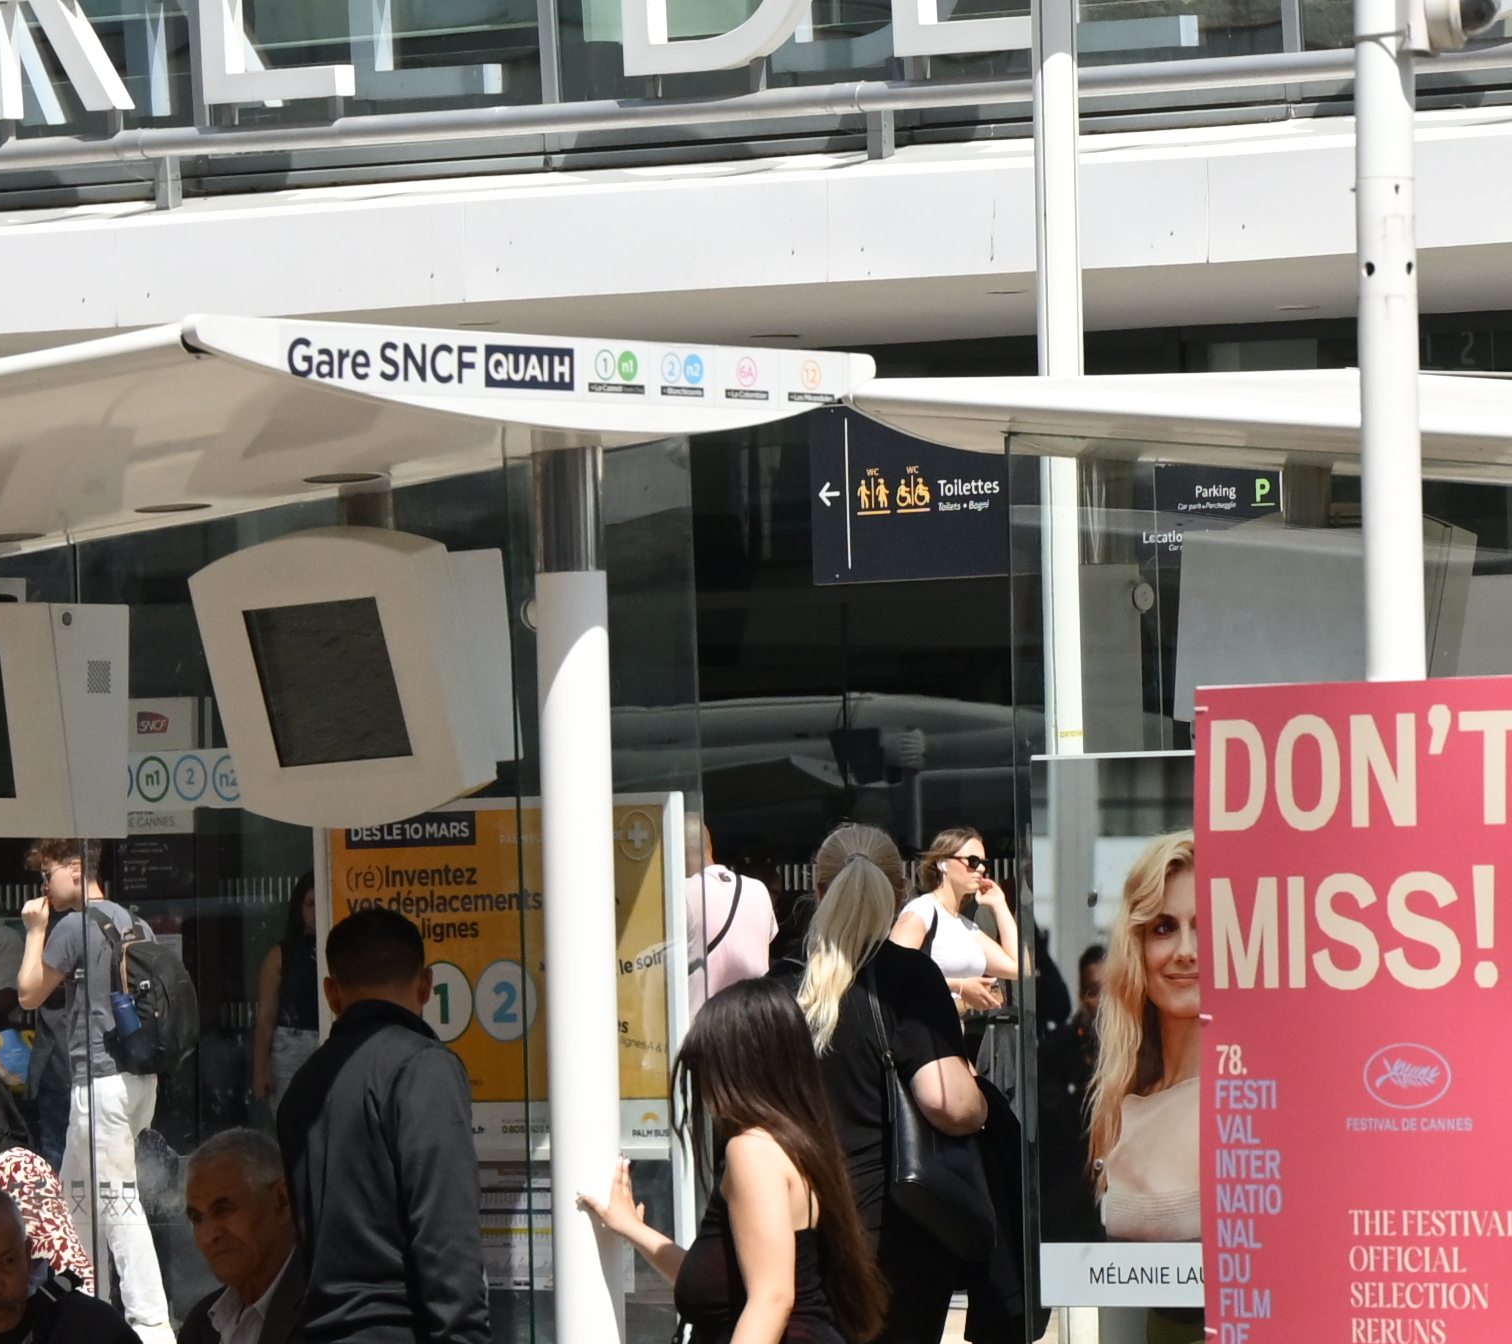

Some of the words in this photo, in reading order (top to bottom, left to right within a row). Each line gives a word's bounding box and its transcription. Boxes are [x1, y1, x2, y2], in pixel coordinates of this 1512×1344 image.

[287, 336, 370, 382] Gare
[380, 341, 478, 386] SNCF
[488, 352, 550, 384] QUAI
[552, 356, 571, 384] H
[621, 359, 634, 374] n1
[667, 360, 676, 376] 2
[686, 362, 701, 377] n2
[739, 364, 754, 379] 6A
[805, 367, 818, 383] 12
[937, 479, 1000, 497] Toilettes
[1195, 484, 1237, 500] Parking
[1255, 478, 1271, 503] P
[938, 501, 961, 511] Toilets
[1177, 502, 1187, 510] Car
[1188, 501, 1202, 511] park
[1142, 529, 1183, 544] Locatio
[139, 718, 168, 732] SNCF
[145, 769, 161, 787] n1
[185, 767, 196, 786] 2
[137, 816, 176, 828] CANNES
[384, 823, 402, 840] LE
[404, 822, 423, 839] 10
[425, 820, 470, 839] MARS
[346, 865, 478, 892] (ré)Inventez
[389, 888, 543, 916] déplacements
[420, 920, 480, 943] lignes
[1209, 864, 1500, 991] MISS!
[619, 958, 633, 975] le
[636, 949, 663, 970] soir
[432, 983, 450, 1024] 1
[492, 982, 518, 1023] 2
[1215, 1044, 1247, 1076] 78.
[1215, 1079, 1278, 1110] FESTI
[632, 1129, 653, 1137] PALM
[654, 1129, 671, 1137] BUS
[1216, 1114, 1261, 1144] VAL
[1346, 1117, 1398, 1131] FESTIVAL
[1402, 1117, 1418, 1131] DE
[1421, 1117, 1473, 1131] CANNES
[1215, 1149, 1281, 1180] INTER
[1216, 1183, 1282, 1215] NATIO
[1217, 1218, 1263, 1249] NAL
[1348, 1209, 1397, 1237] THE
[1218, 1252, 1251, 1284] DU
[1348, 1245, 1468, 1274] OFFICIAL
[1088, 1262, 1171, 1286] MÉLANIE
[1219, 1287, 1272, 1319] FILM
[1349, 1281, 1489, 1310] SELECTION
